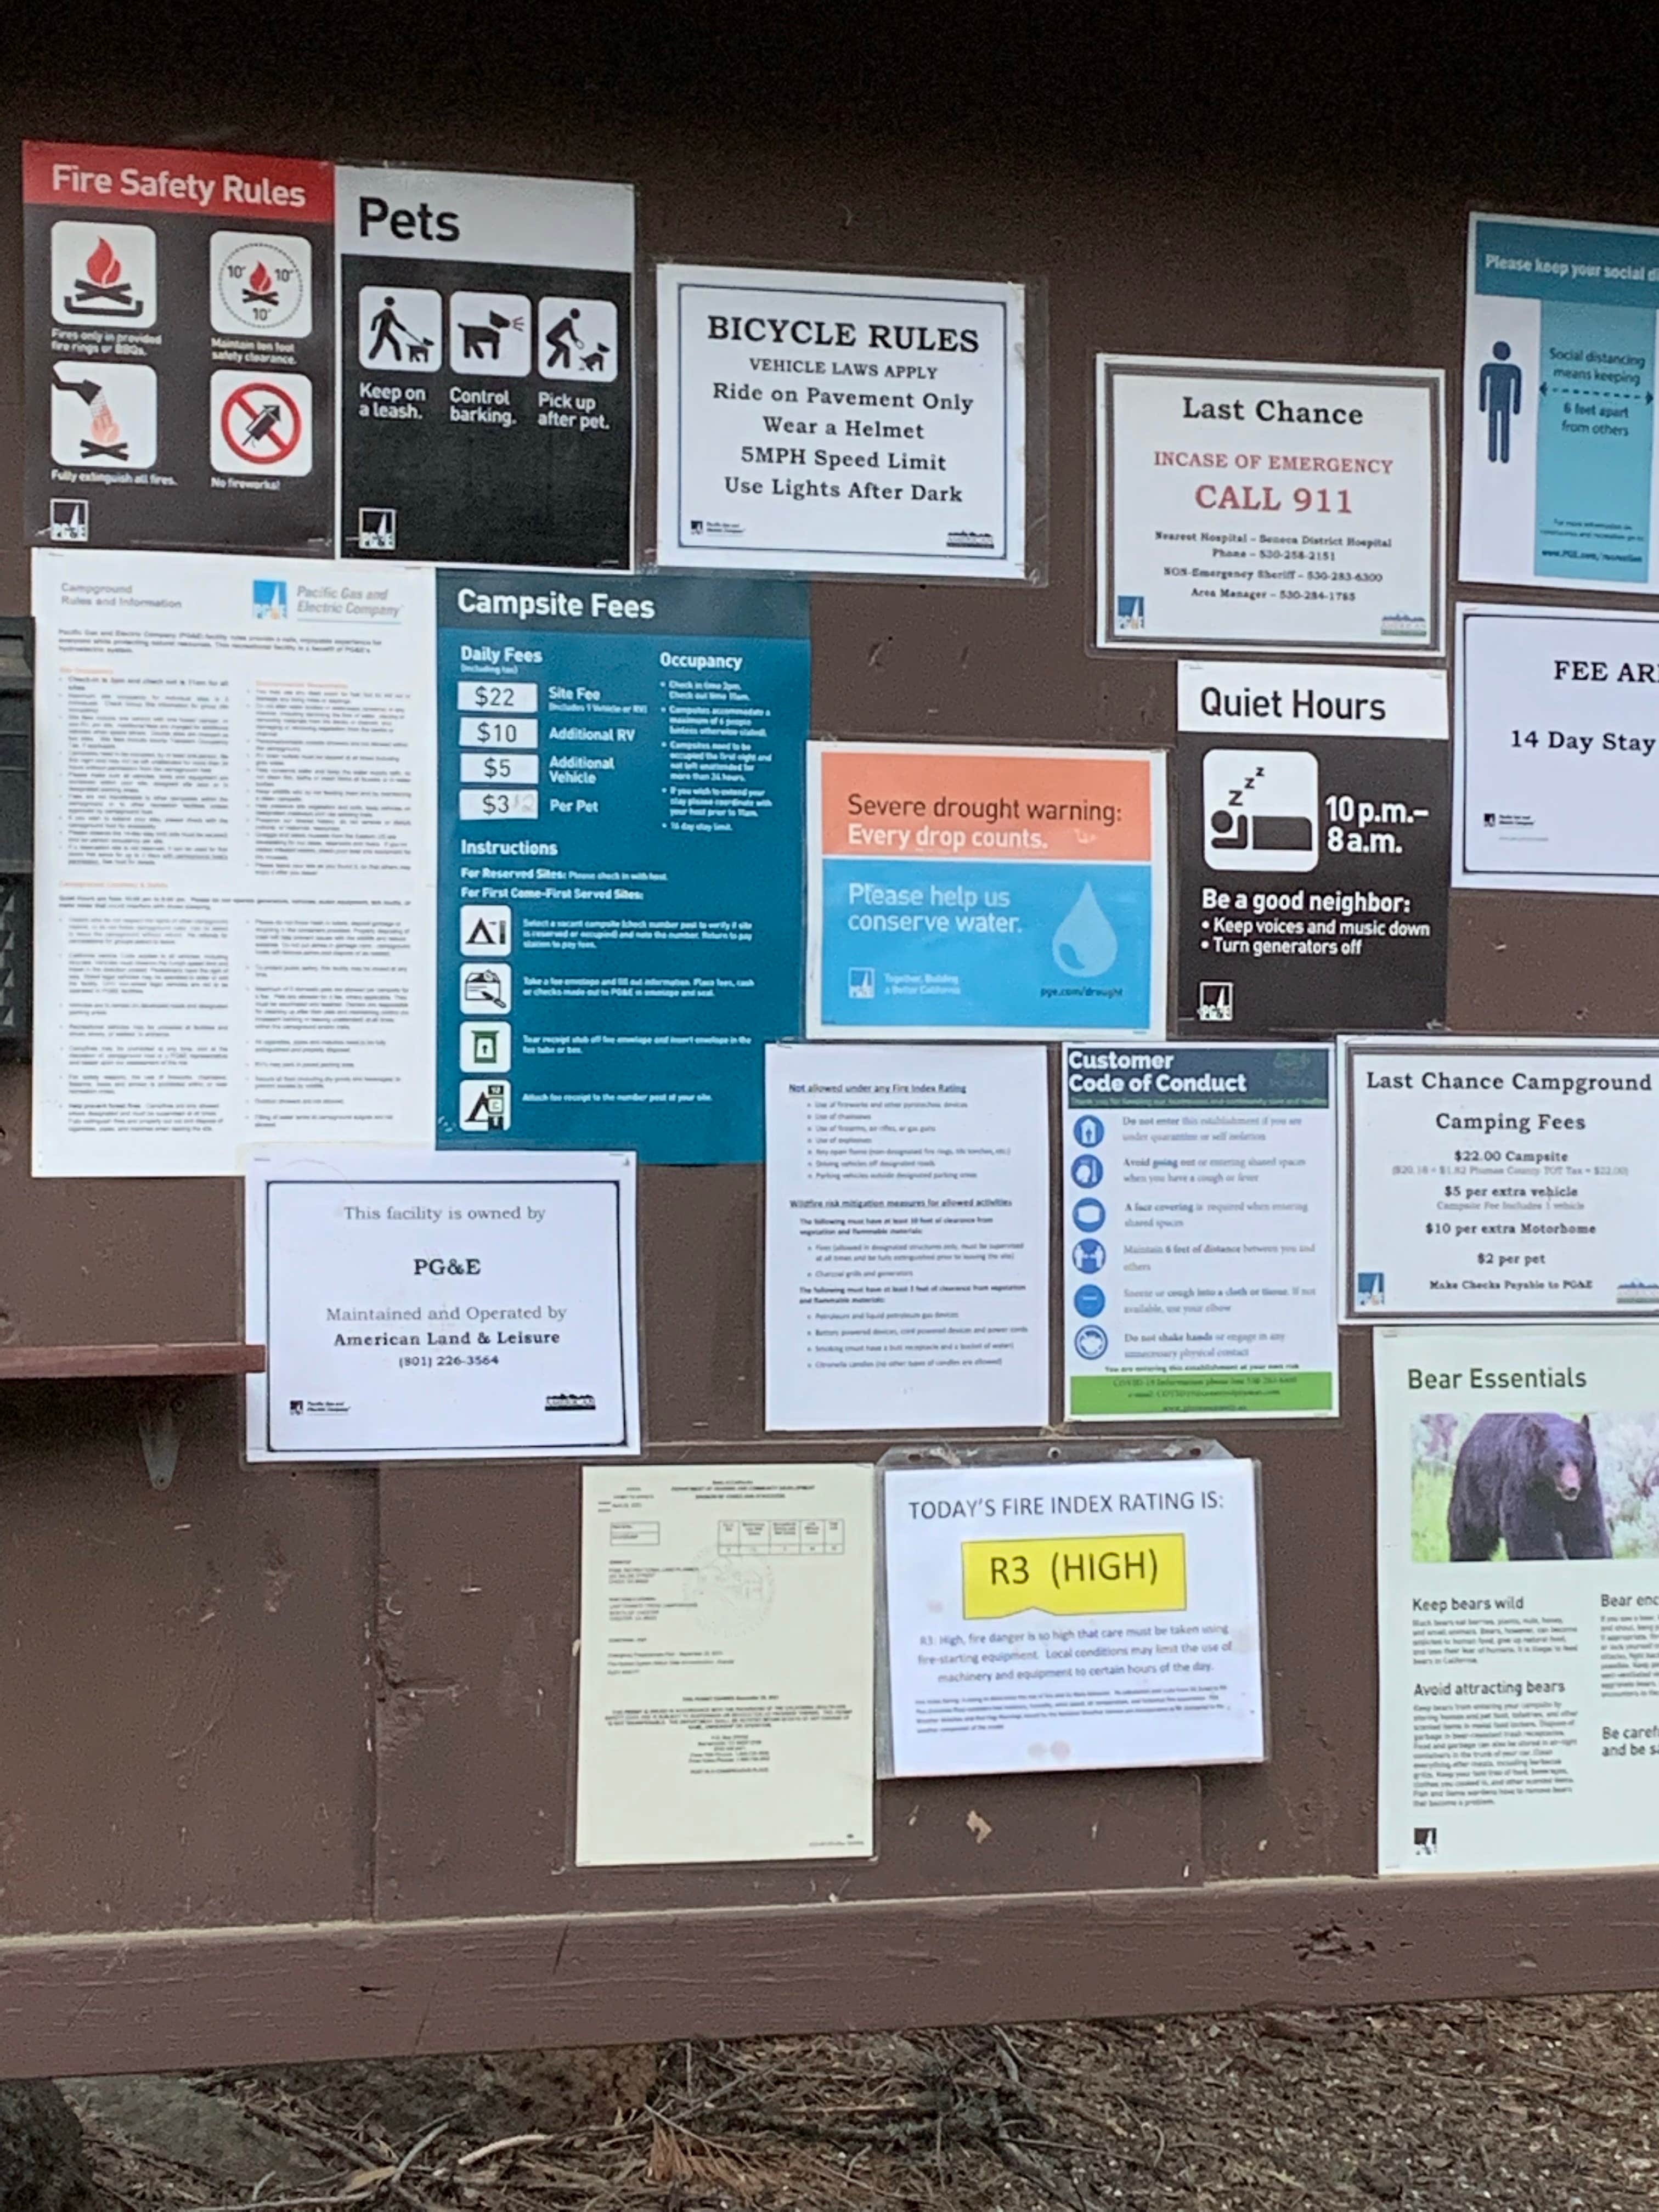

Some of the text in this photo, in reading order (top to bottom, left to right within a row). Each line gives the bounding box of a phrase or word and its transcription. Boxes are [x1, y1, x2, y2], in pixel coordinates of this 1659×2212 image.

[53, 163, 306, 208] Fire Safety Rules
[359, 196, 460, 242] Pets
[1486, 253, 1645, 281] Please keep your social
[708, 315, 979, 353] BICYCLE RULES
[749, 358, 938, 380] VEHICLE LAWS APPLY
[1549, 347, 1646, 370] Social distancing
[1553, 368, 1641, 387] means keeping
[360, 382, 426, 402] Keep on
[449, 386, 510, 405] Control
[539, 391, 596, 412] Pick up
[713, 382, 974, 415] Ride on Pavement Only
[359, 403, 422, 420] a leash.
[450, 405, 517, 427] barking.
[538, 410, 610, 430] after pet.
[1183, 396, 1363, 425] Last Chance
[1563, 402, 1628, 419] 6 feet apart
[763, 416, 924, 439] Wear a Helmet
[1561, 420, 1629, 437] from others
[741, 446, 946, 471] 5MPH Speed Limit
[1154, 451, 1393, 475] INCASE OF EMERGENCY
[724, 476, 962, 503] Use Lights After Dark
[1195, 484, 1352, 514] CALL 911
[458, 588, 655, 620] Campsite Fees
[461, 645, 543, 664] Daily Fees
[660, 651, 743, 672] Occupancy
[1554, 660, 1658, 684] FEE AR
[475, 686, 514, 708] $22
[548, 686, 600, 701] Site Fee
[1200, 686, 1386, 721] Quiet Hours
[477, 721, 517, 743] $10
[549, 727, 635, 742] Additional RV
[1512, 730, 1656, 757] 14 Day Stay
[484, 757, 511, 779] $5
[549, 755, 615, 770] Additional
[549, 770, 597, 784] Vehicle
[483, 793, 509, 815] $3
[550, 798, 599, 812] Per Pet
[848, 793, 1121, 827] Severe drought warning:
[1325, 795, 1355, 822] 10
[461, 839, 558, 856] Instructions
[849, 823, 1048, 850] Every drop counts.
[1328, 826, 1403, 854] 8 a.m.
[848, 882, 1010, 912] Please help us
[1202, 888, 1410, 917] Be a good neighbor:
[848, 915, 1022, 933] conserve water.
[1213, 917, 1430, 936] Keep voices and music down
[1212, 936, 1362, 957] Turn generators off
[1066, 1049, 1174, 1071] Customer
[1066, 1073, 1247, 1094] Code of Conduct
[1367, 1071, 1652, 1096] Last Chance Campground
[1436, 1113, 1586, 1135] Camping Fees
[1454, 1149, 1568, 1165] $22.00 Campsite
[343, 1205, 545, 1223] This facility is owned by
[414, 1259, 481, 1276] PG&E
[326, 1305, 567, 1324] Maintained and Operated by
[334, 1331, 560, 1346] American Land & Leisure
[399, 1356, 432, 1368] (801)
[1408, 1367, 1587, 1390] Bear Essentials
[908, 1491, 1223, 1520] TODAY'S FIRE INDEX RATING IS:
[991, 1549, 1158, 1589] R3 (HIGH)
[1412, 1596, 1523, 1613] Keep bears wild
[1413, 1680, 1565, 1697] Avoid attracting bears
